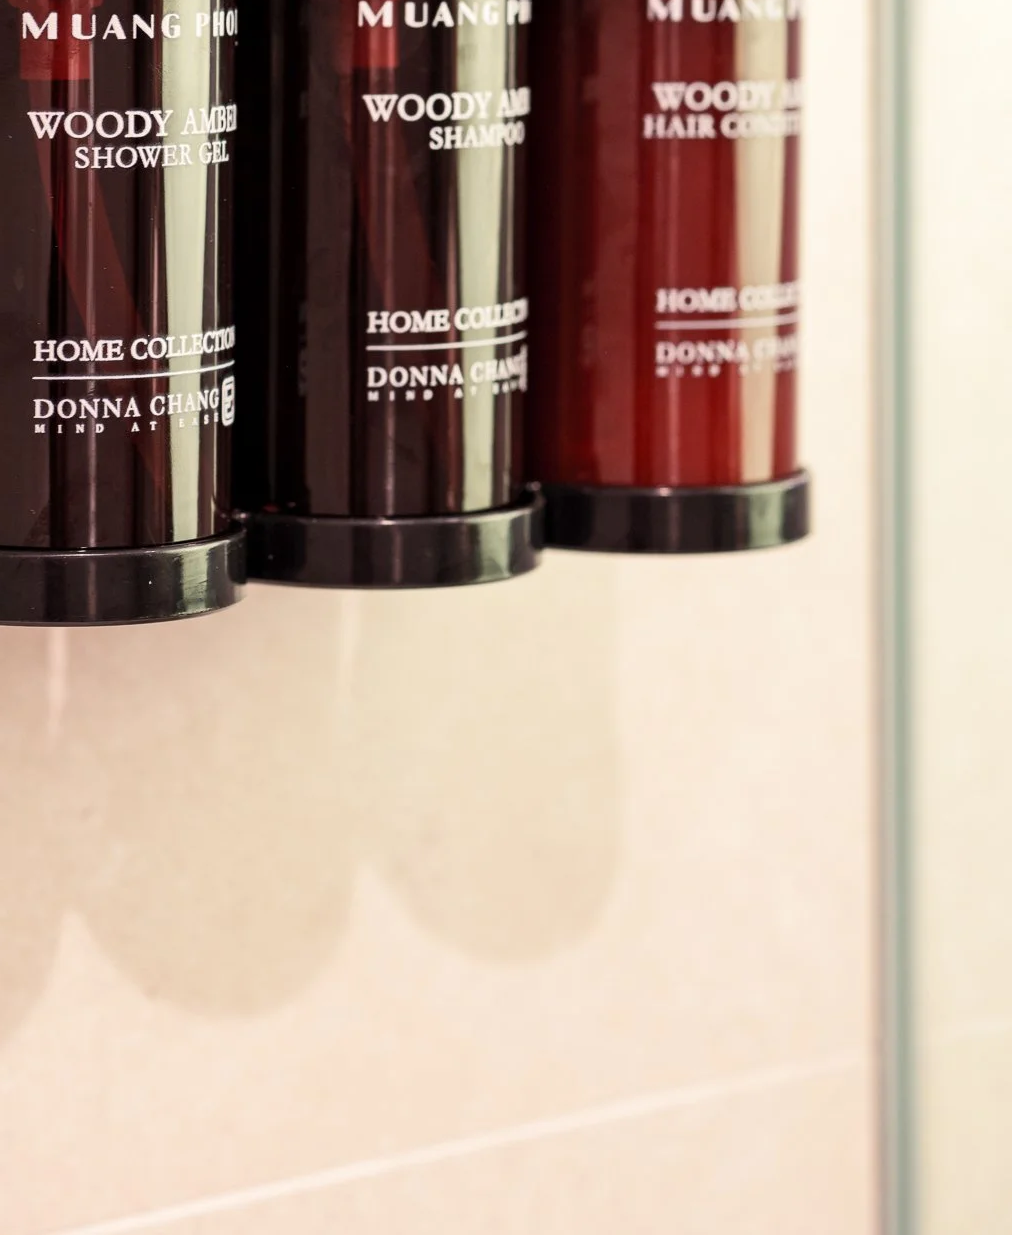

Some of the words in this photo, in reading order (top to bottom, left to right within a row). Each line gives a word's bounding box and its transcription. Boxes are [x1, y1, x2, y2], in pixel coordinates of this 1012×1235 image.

[22, 12, 181, 40] MUANG
[357, 0, 500, 28] MUANG
[362, 91, 493, 123] WOODY
[651, 80, 776, 112] WOODY
[27, 109, 174, 139] WOODY
[428, 120, 526, 151] SHAMPOO
[643, 113, 717, 140] HAIR
[75, 145, 193, 170] SHOWER
[199, 140, 230, 165] GEL
[656, 286, 737, 313] HOME
[366, 309, 451, 334] HOME
[32, 339, 125, 363] HOME
[655, 339, 749, 365] DONNA
[367, 363, 465, 388] DONNA
[33, 396, 141, 419] DONNA
[149, 388, 220, 417] CHANG
[34, 423, 105, 434] MIND
[131, 419, 159, 433] AT
